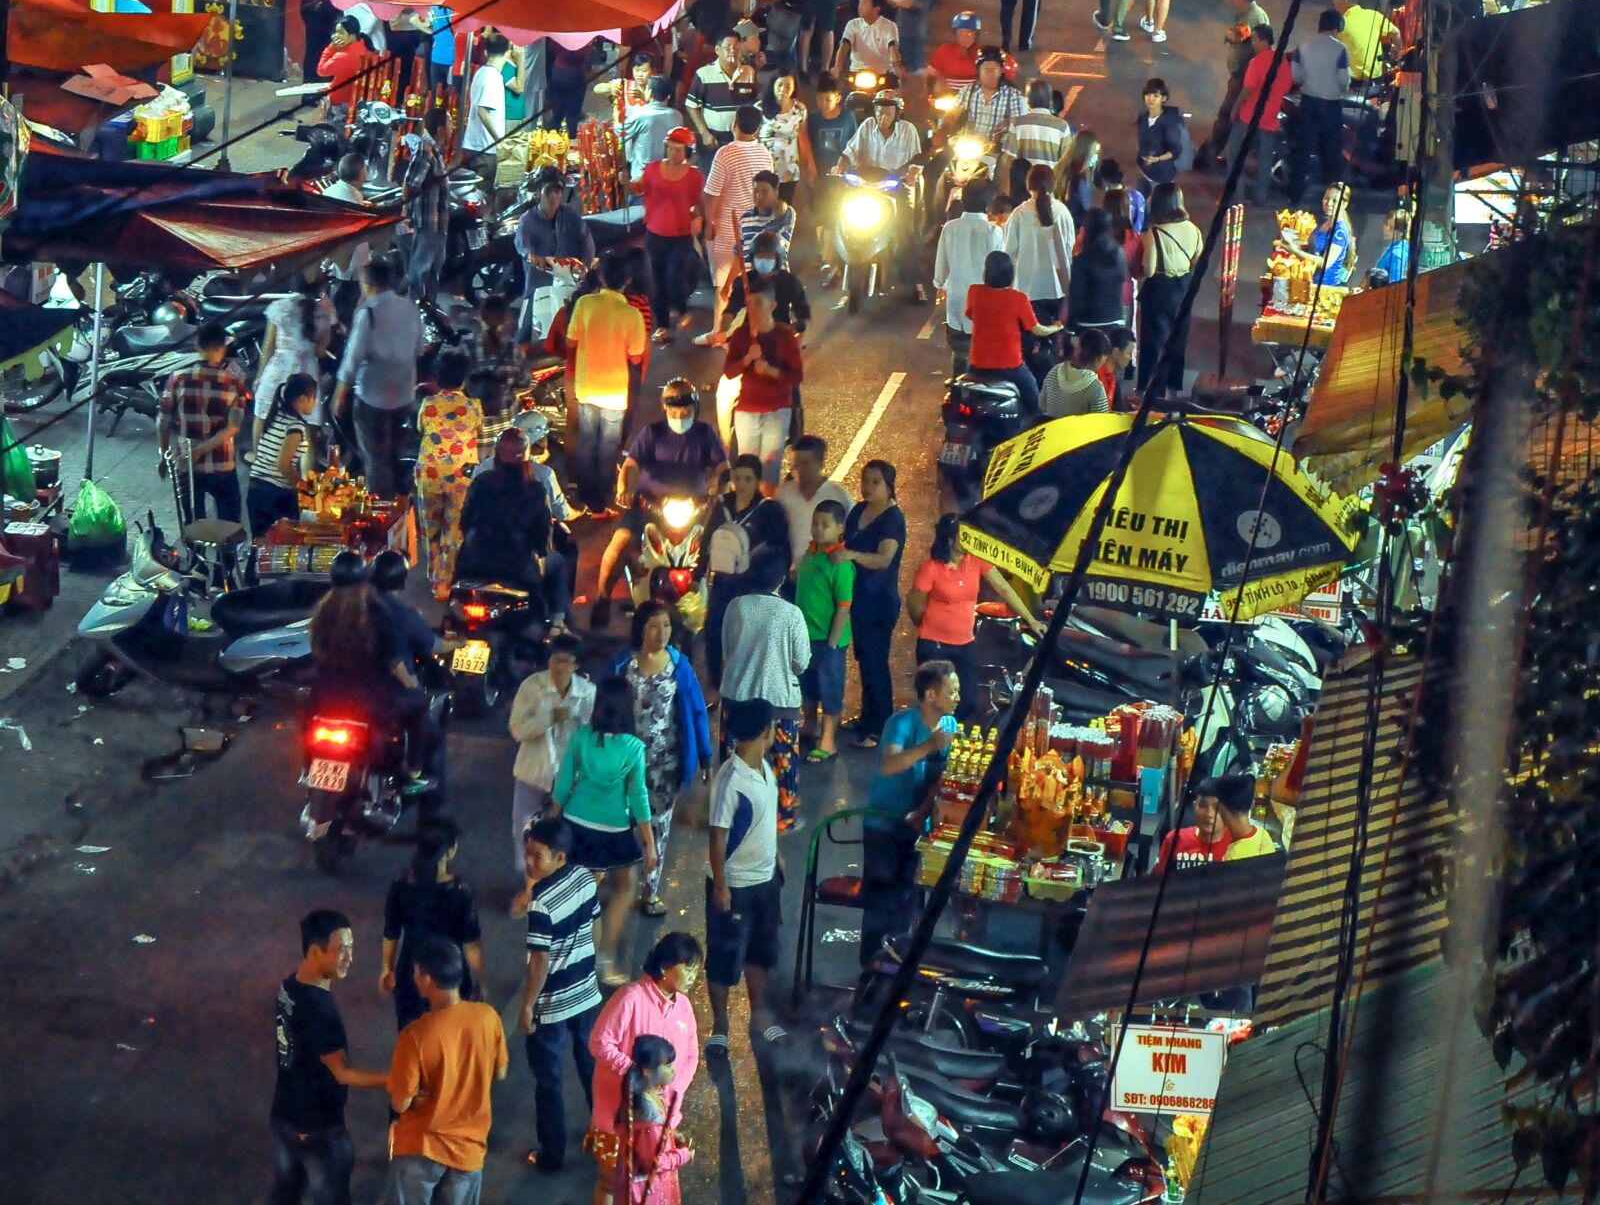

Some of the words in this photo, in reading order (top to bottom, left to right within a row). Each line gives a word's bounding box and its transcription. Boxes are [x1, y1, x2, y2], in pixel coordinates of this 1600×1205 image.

[1100, 507, 1146, 532] IÊU
[1152, 516, 1189, 544] THỊ
[1138, 547, 1189, 573] MÁY
[1087, 582, 1129, 602] 1900
[1132, 586, 1164, 609] 561
[1165, 592, 1200, 614] 292
[453, 658, 485, 672] 31972
[1137, 1034, 1163, 1047] TIỆM
[1165, 1037, 1203, 1049] NHANG
[1152, 1052, 1187, 1074] KIM
[1124, 1092, 1147, 1105] SĐT:
